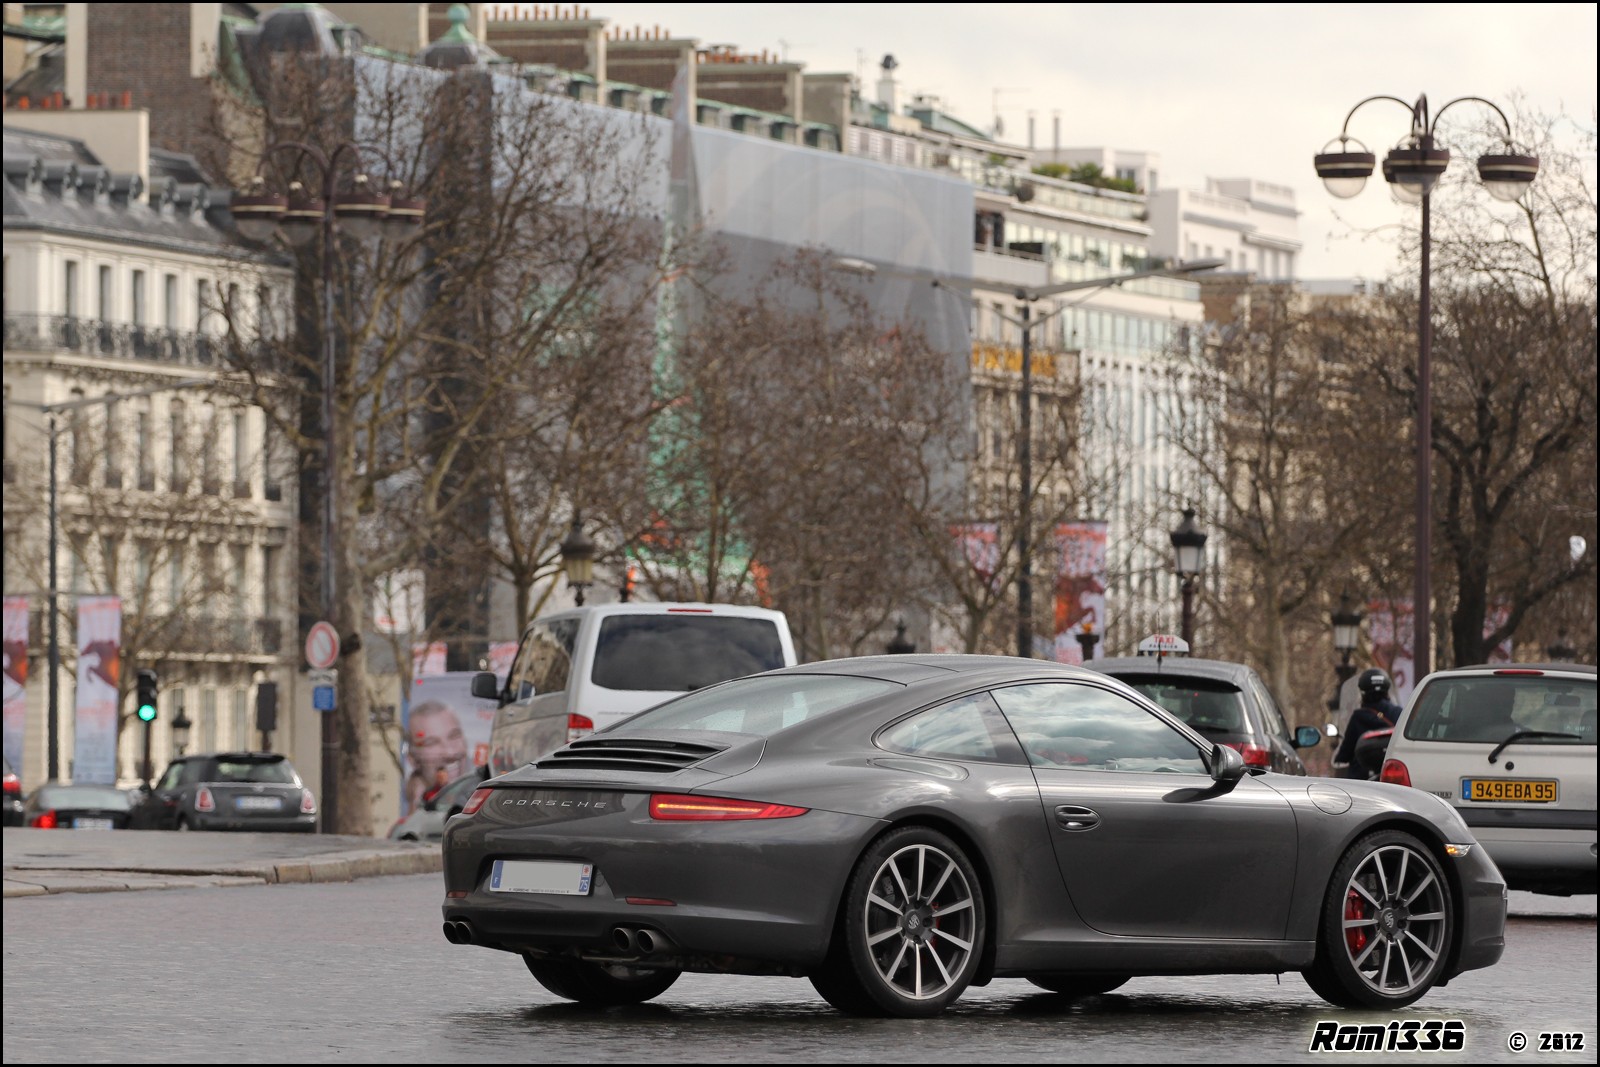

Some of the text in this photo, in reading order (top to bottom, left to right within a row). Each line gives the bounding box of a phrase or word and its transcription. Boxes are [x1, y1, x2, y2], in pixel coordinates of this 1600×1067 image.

[1153, 634, 1175, 644] TAXI
[502, 799, 607, 808] PORSCHE
[580, 880, 588, 890] 75
